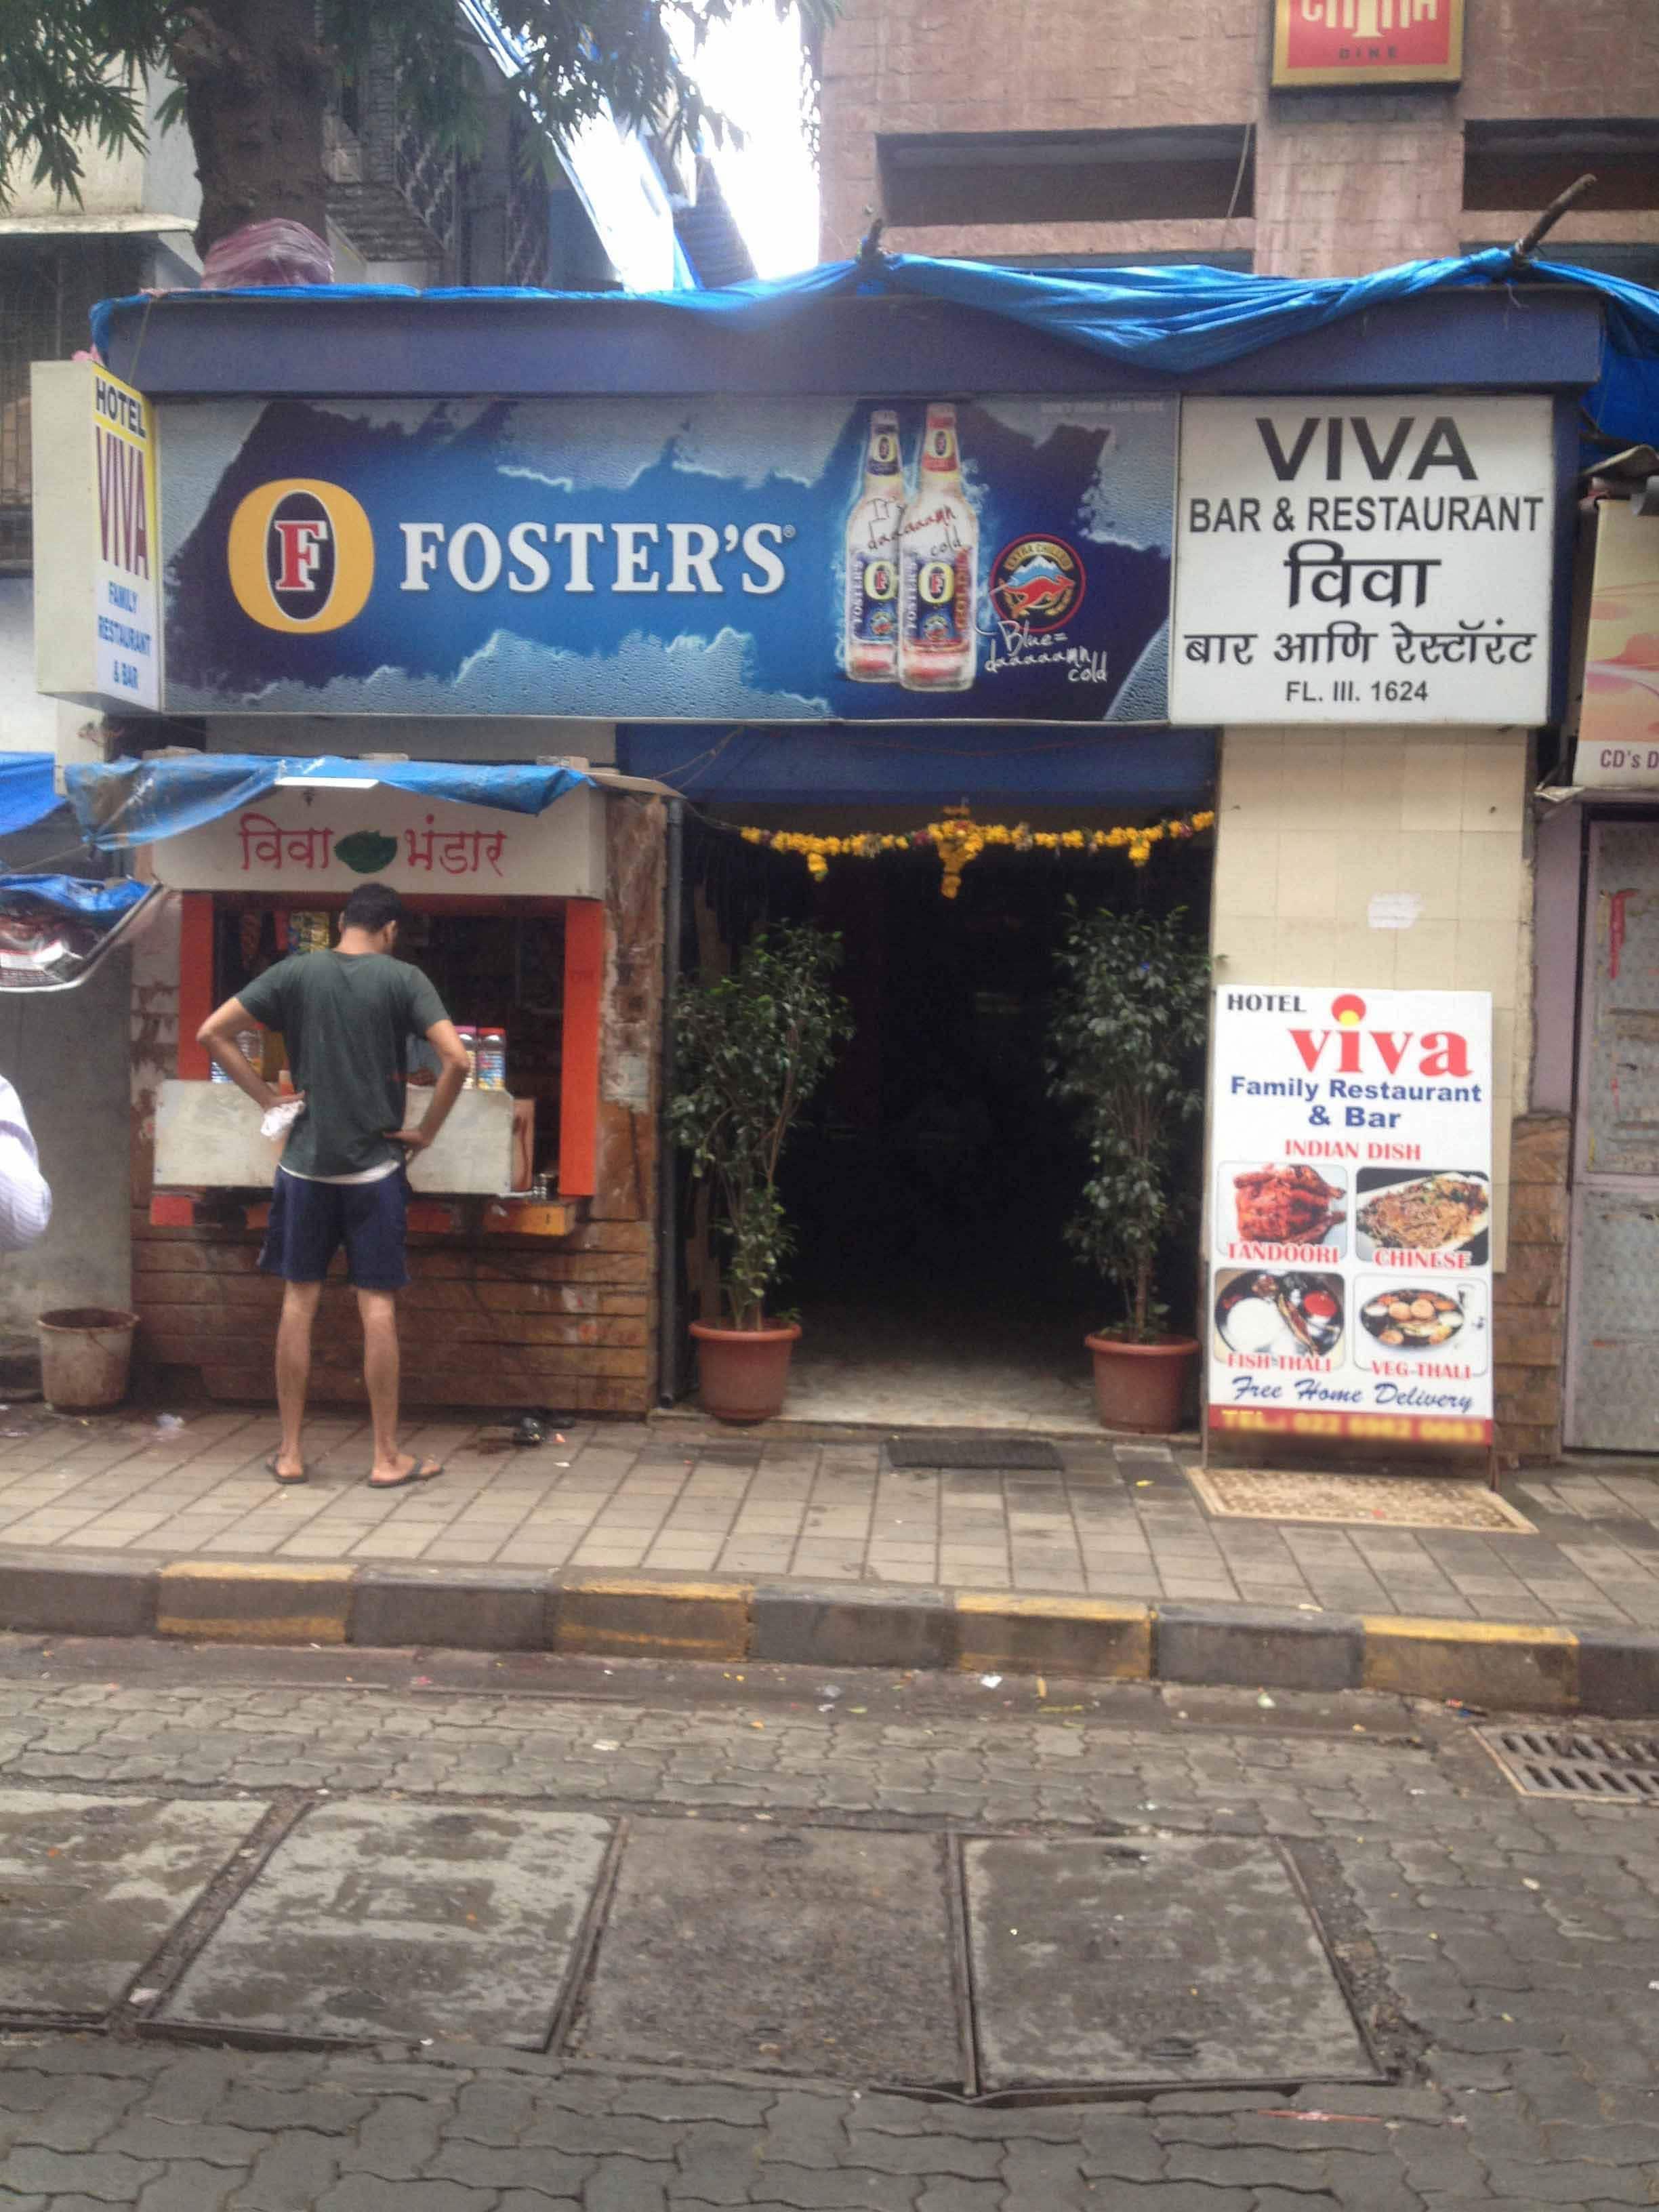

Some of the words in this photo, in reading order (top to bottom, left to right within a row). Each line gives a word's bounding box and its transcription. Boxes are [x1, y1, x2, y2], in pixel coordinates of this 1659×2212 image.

[95, 376, 147, 439] HOTEL
[1256, 416, 1478, 481] VIVA
[96, 426, 149, 581] VIVA
[1189, 497, 1261, 533] BAR
[1272, 496, 1296, 533] &
[1307, 496, 1544, 532] RESTAURANT
[399, 520, 786, 594] FOSTER'S
[930, 525, 963, 556] cold
[1284, 539, 1441, 609] विवा
[98, 613, 151, 657] RESTAURANT
[1183, 632, 1258, 665] बार
[1273, 620, 1378, 665] आणि
[1391, 617, 1537, 665] रेस्टॉरंट
[121, 661, 139, 691] BAR
[1068, 651, 1108, 683] cold
[1286, 680, 1324, 702] FL.
[1370, 680, 1428, 702] 1624
[1600, 749, 1641, 769] CD's
[238, 813, 334, 871] विवा
[405, 813, 508, 877] भंडार
[1227, 994, 1307, 1013] HOTEL
[1288, 994, 1473, 1078] viva
[1230, 1075, 1319, 1102] Family
[1329, 1078, 1483, 1103] Restaurant
[1308, 1104, 1331, 1126] &
[1345, 1105, 1401, 1128] Bar
[1285, 1139, 1359, 1160] INDIAN
[1368, 1141, 1422, 1162] DISH
[1227, 1242, 1340, 1265] TANDOORI
[1372, 1249, 1472, 1270] CHINESE
[1231, 1375, 1283, 1401] Free
[1293, 1378, 1364, 1404] Home
[1372, 1382, 1474, 1414] Delivery
